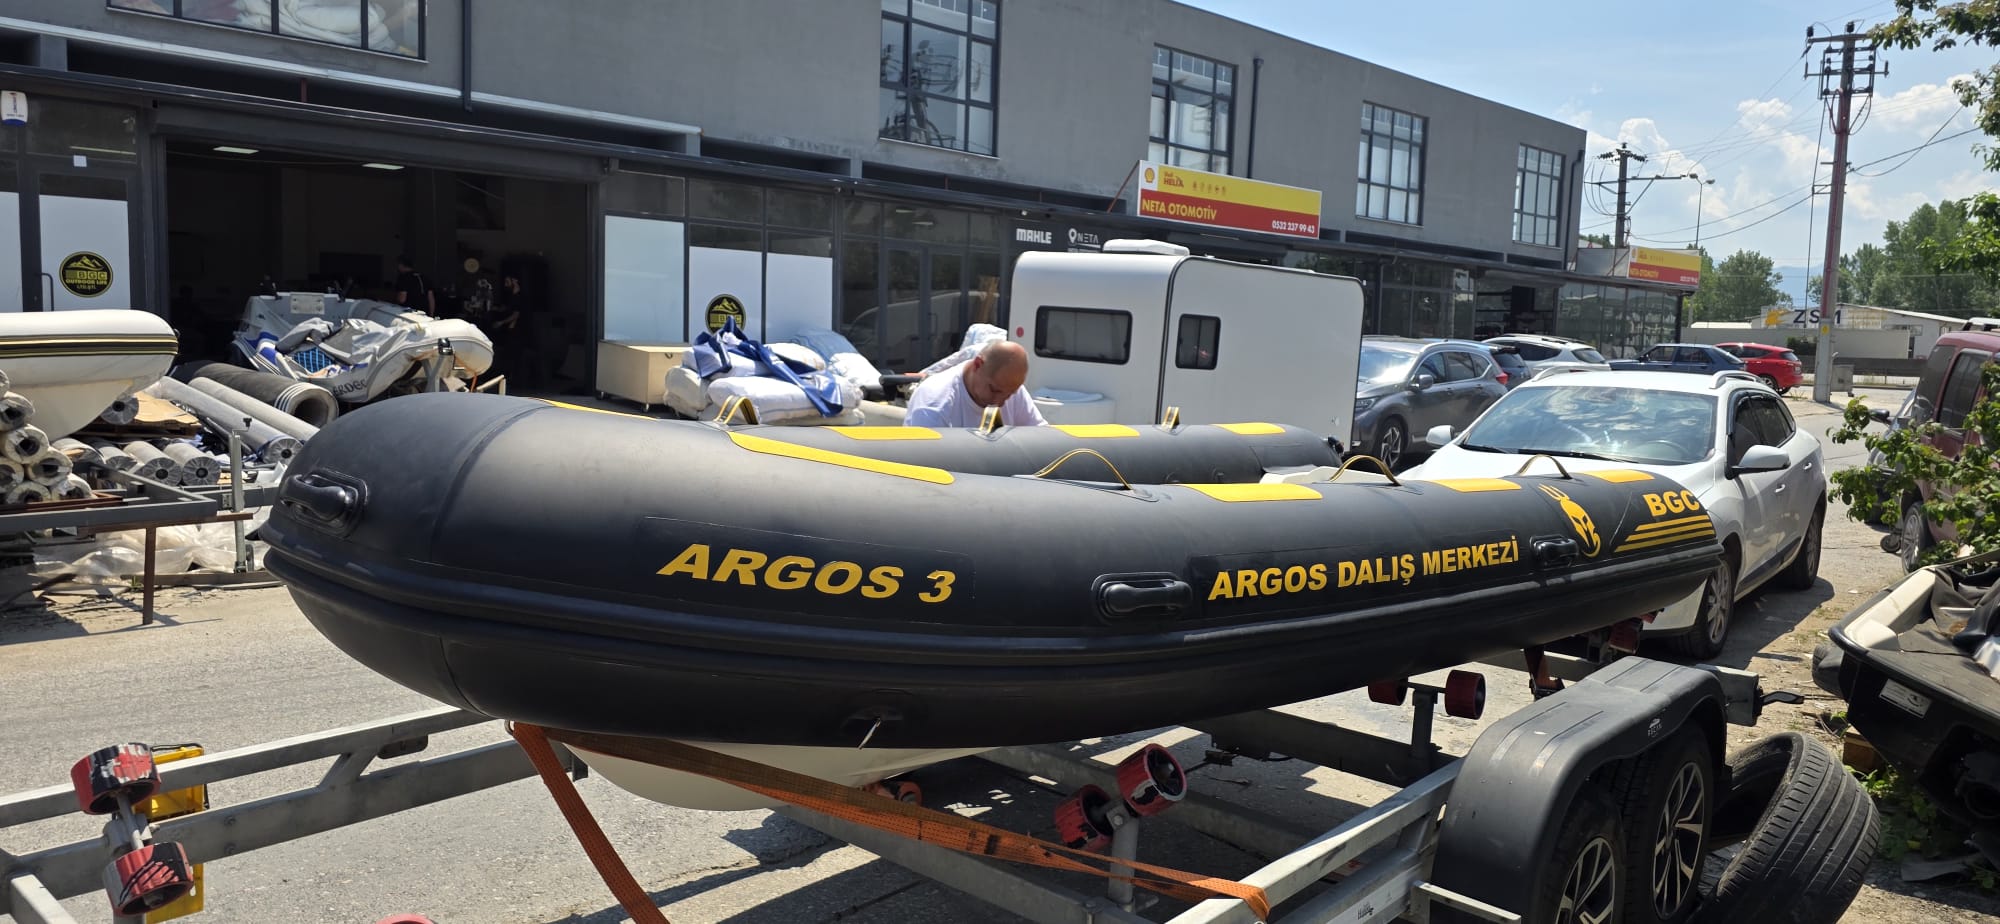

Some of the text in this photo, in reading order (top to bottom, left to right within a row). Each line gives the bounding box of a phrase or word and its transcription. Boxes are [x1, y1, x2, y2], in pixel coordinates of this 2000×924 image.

[1142, 199, 1217, 220] NETA OTOMOTİV
[1016, 228, 1052, 245] MAHLE
[1077, 232, 1099, 244] NETA
[1299, 224, 1307, 233] 99
[78, 271, 107, 280] BGC
[1643, 490, 1700, 517] BGC
[656, 543, 956, 603] ARGOS 3
[1208, 535, 1519, 600] ARGOS DALIŞ MERKEZİ
